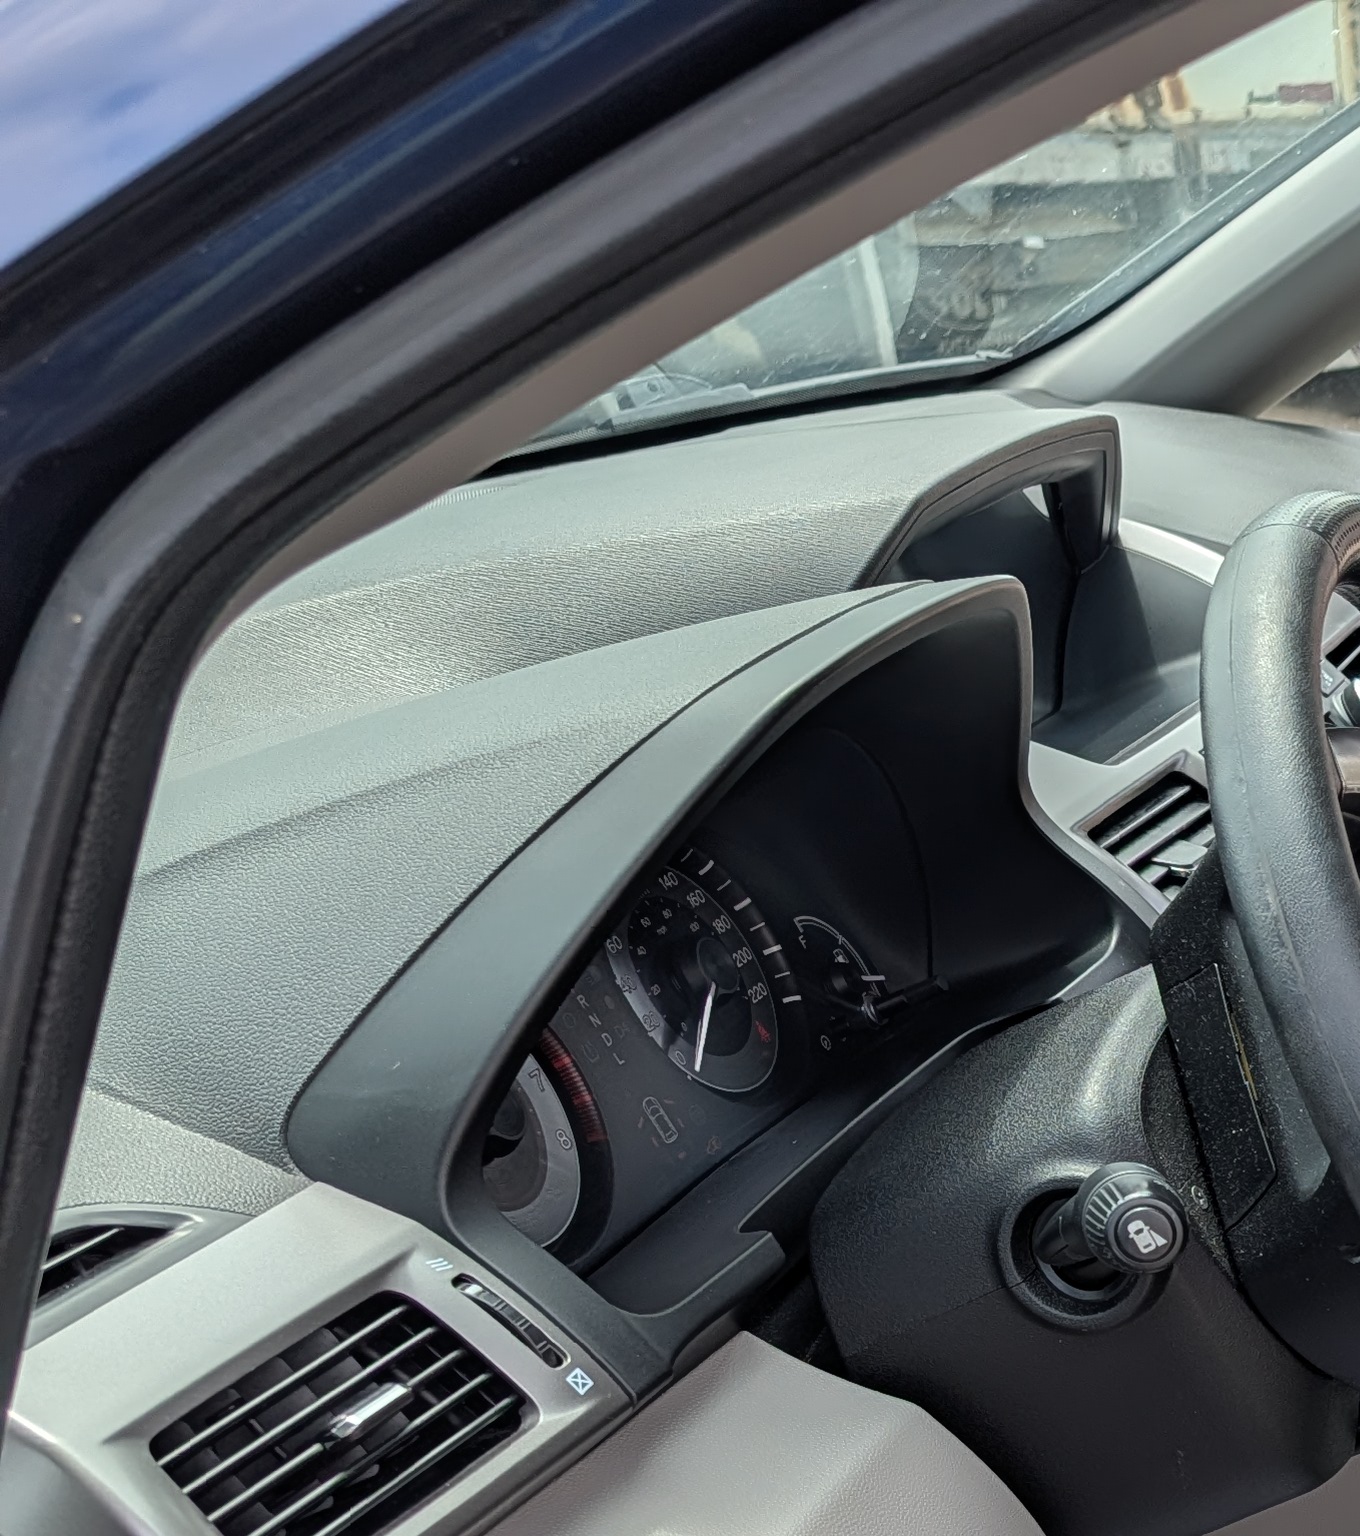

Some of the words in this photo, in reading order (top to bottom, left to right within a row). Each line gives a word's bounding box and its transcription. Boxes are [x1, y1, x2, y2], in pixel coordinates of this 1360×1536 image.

[658, 871, 679, 890] 140
[687, 889, 706, 908] 160
[712, 914, 732, 935] 180
[606, 935, 624, 955] 60
[732, 946, 753, 969] 200
[576, 993, 590, 1009] R
[747, 981, 769, 1005] 220
[588, 1012, 602, 1028] N
[601, 1031, 613, 1047] D
[528, 1066, 546, 1093] 7
[555, 1128, 573, 1149] 8
